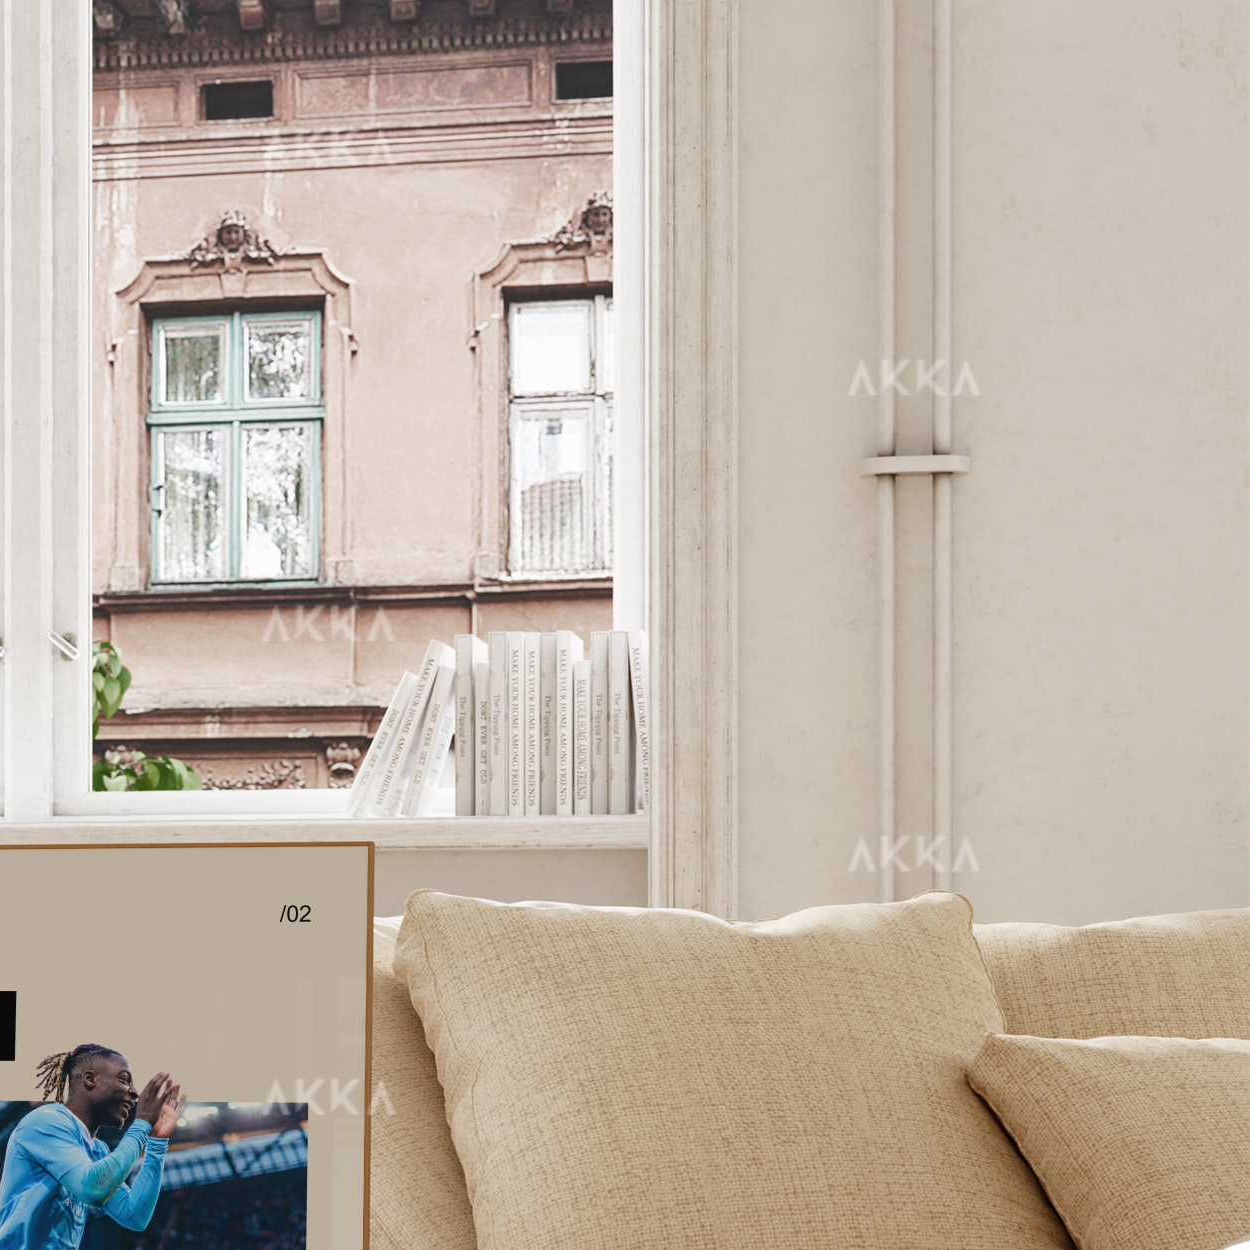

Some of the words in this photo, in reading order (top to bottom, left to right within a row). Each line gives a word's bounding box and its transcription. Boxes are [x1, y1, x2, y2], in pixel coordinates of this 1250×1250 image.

[420, 657, 435, 682] MAKE
[632, 647, 641, 673] MAKE
[410, 684, 426, 707] YOUR
[634, 674, 643, 700] YOUR
[401, 708, 416, 735] HOME
[458, 710, 466, 738] Tipping
[492, 709, 500, 736] Tipping
[543, 710, 551, 736] Tipping
[595, 708, 603, 736] Tipping
[637, 701, 646, 729] HOME
[375, 730, 389, 750] EVER
[423, 726, 434, 746] EVER
[639, 730, 649, 765] AMONG
[367, 753, 378, 768] GET
[389, 735, 405, 768] AMONG
[418, 750, 427, 766] GET
[359, 770, 370, 785] OLD
[378, 769, 394, 805] FRIENDS
[413, 769, 422, 784] OLD
[280, 904, 312, 922] /02
